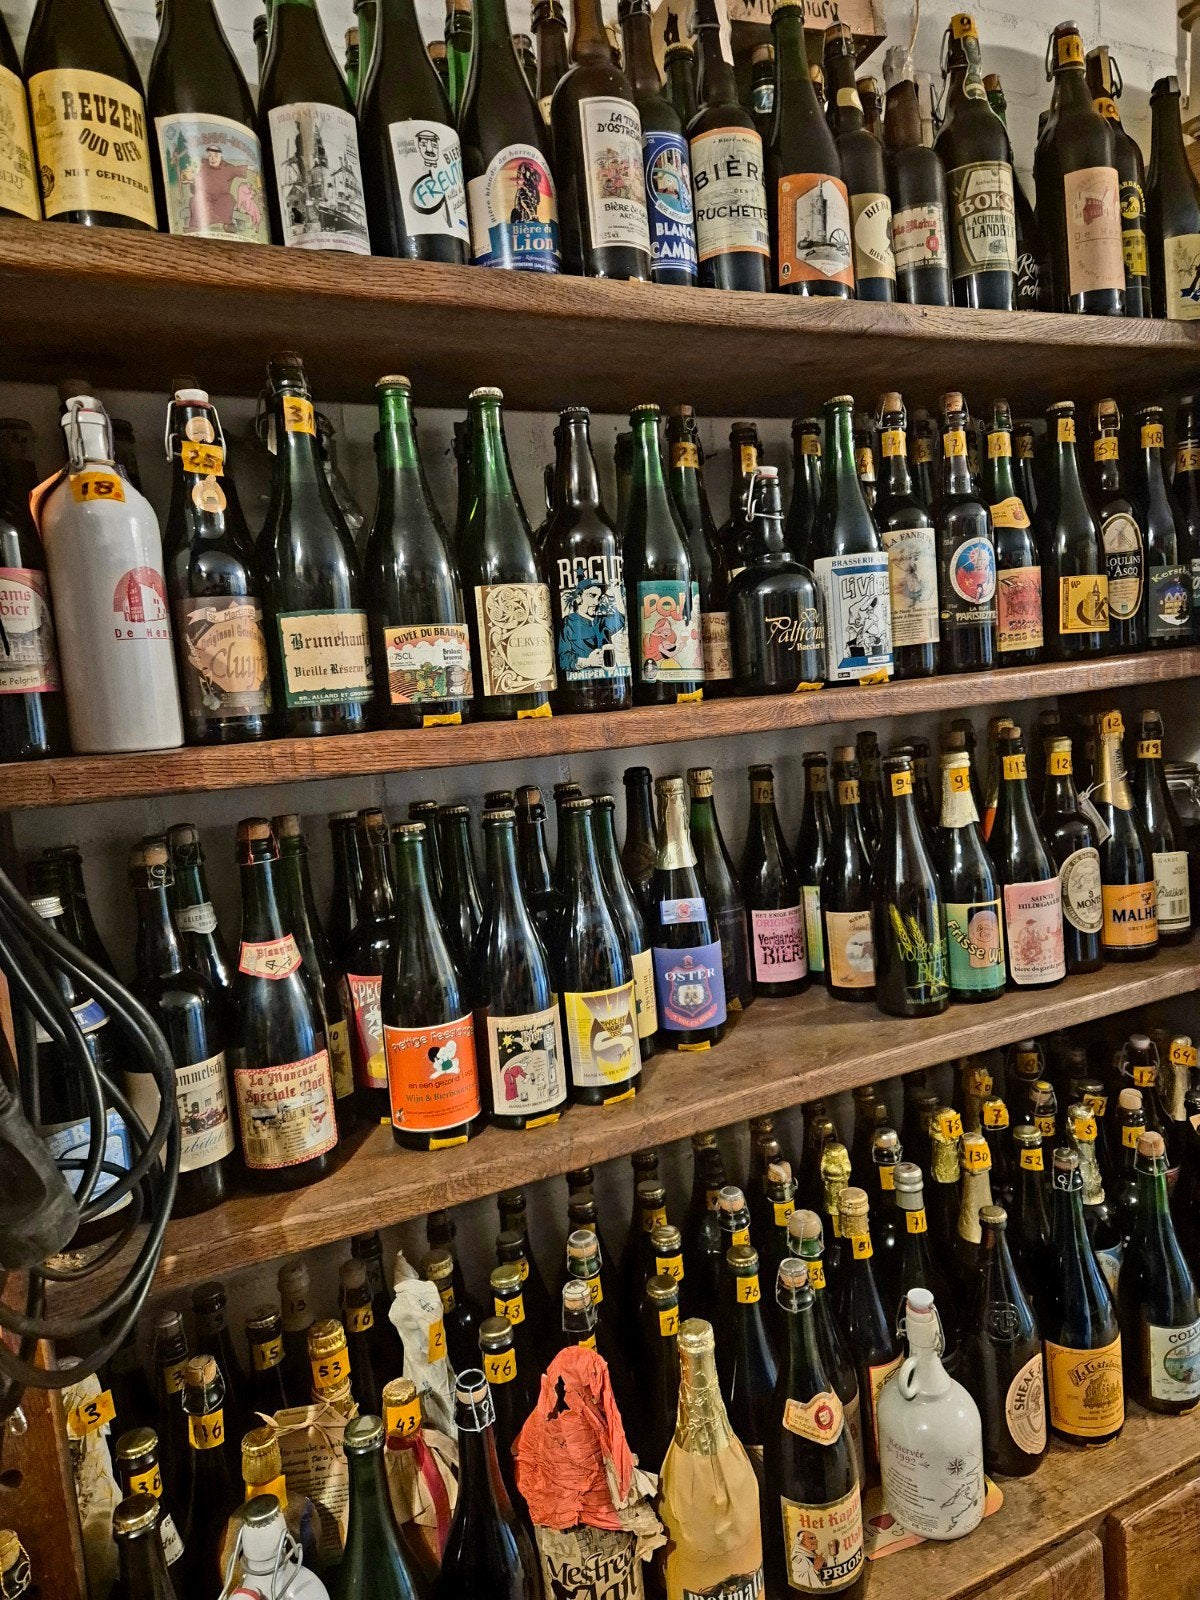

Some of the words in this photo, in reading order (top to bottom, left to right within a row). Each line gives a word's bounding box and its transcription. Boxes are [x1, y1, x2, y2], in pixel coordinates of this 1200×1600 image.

[62, 90, 145, 140] REUZEN
[78, 127, 109, 157] OUD
[113, 140, 143, 163] BIER
[96, 169, 150, 194] GEFILTERD
[512, 225, 543, 235] Bière
[512, 233, 554, 252] Lion
[1149, 430, 1164, 446] 48
[1177, 453, 1198, 469] 45
[115, 628, 134, 639] De
[420, 628, 433, 637] DU
[434, 627, 466, 641] BRABANT
[947, 920, 985, 960] Frisse
[664, 967, 716, 981] OSTER
[1173, 1048, 1191, 1062] 64
[249, 1075, 263, 1088] La
[245, 1086, 296, 1105] Spéciale
[1085, 1124, 1094, 1135] 5
[1023, 1154, 1042, 1167] 52
[434, 1332, 443, 1347] 2
[318, 1360, 343, 1378] 53
[490, 1357, 513, 1377] 46
[1014, 1366, 1036, 1411] SHEAF
[84, 1402, 102, 1426] 3
[396, 1415, 417, 1432] 43
[799, 1513, 825, 1529] Het
